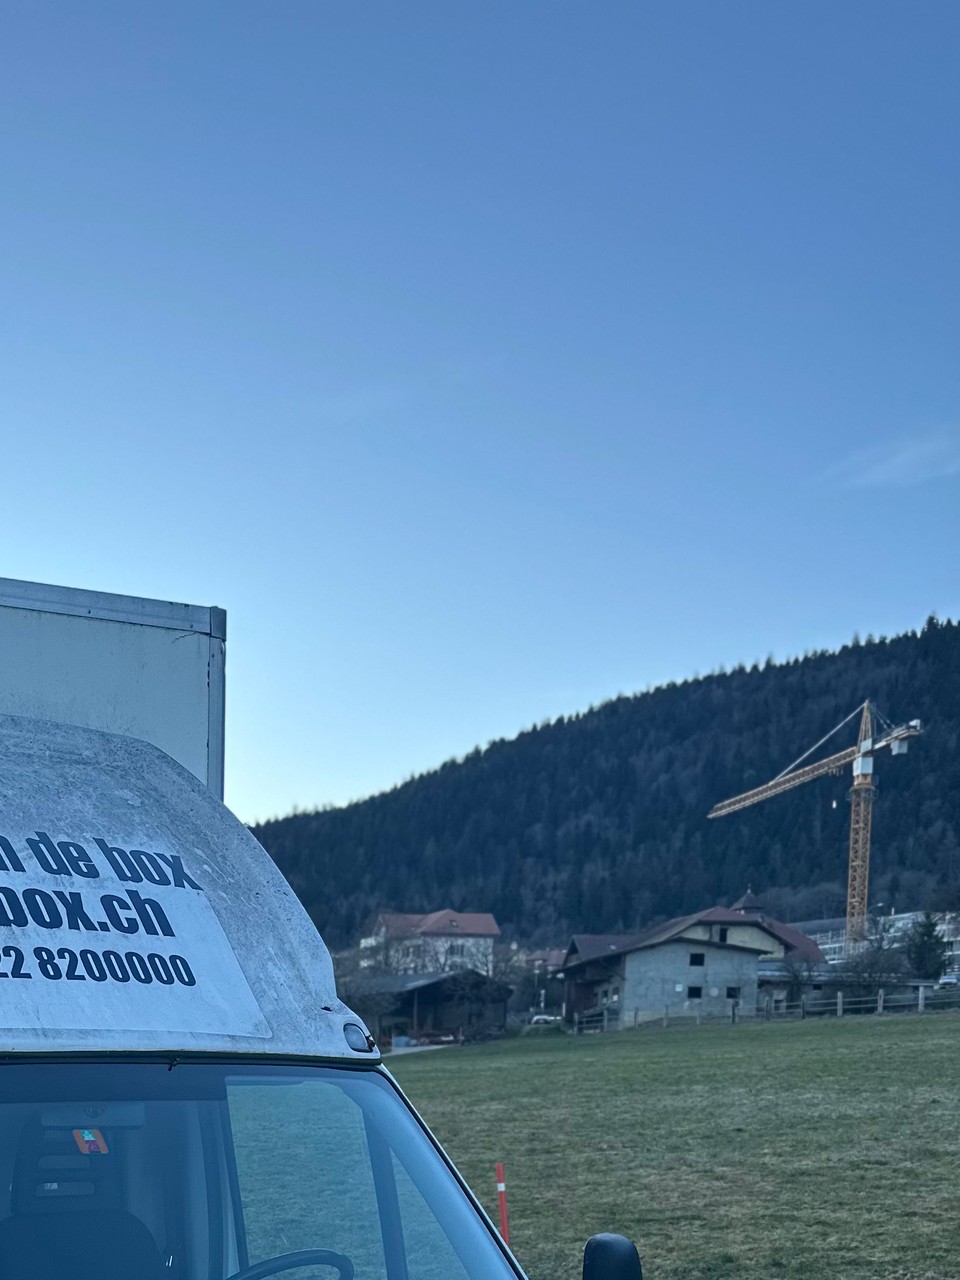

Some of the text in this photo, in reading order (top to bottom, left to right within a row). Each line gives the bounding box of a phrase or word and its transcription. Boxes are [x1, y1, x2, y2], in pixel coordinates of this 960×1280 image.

[26, 831, 100, 880] de
[93, 836, 203, 891] box
[34, 946, 197, 987] 8200000
